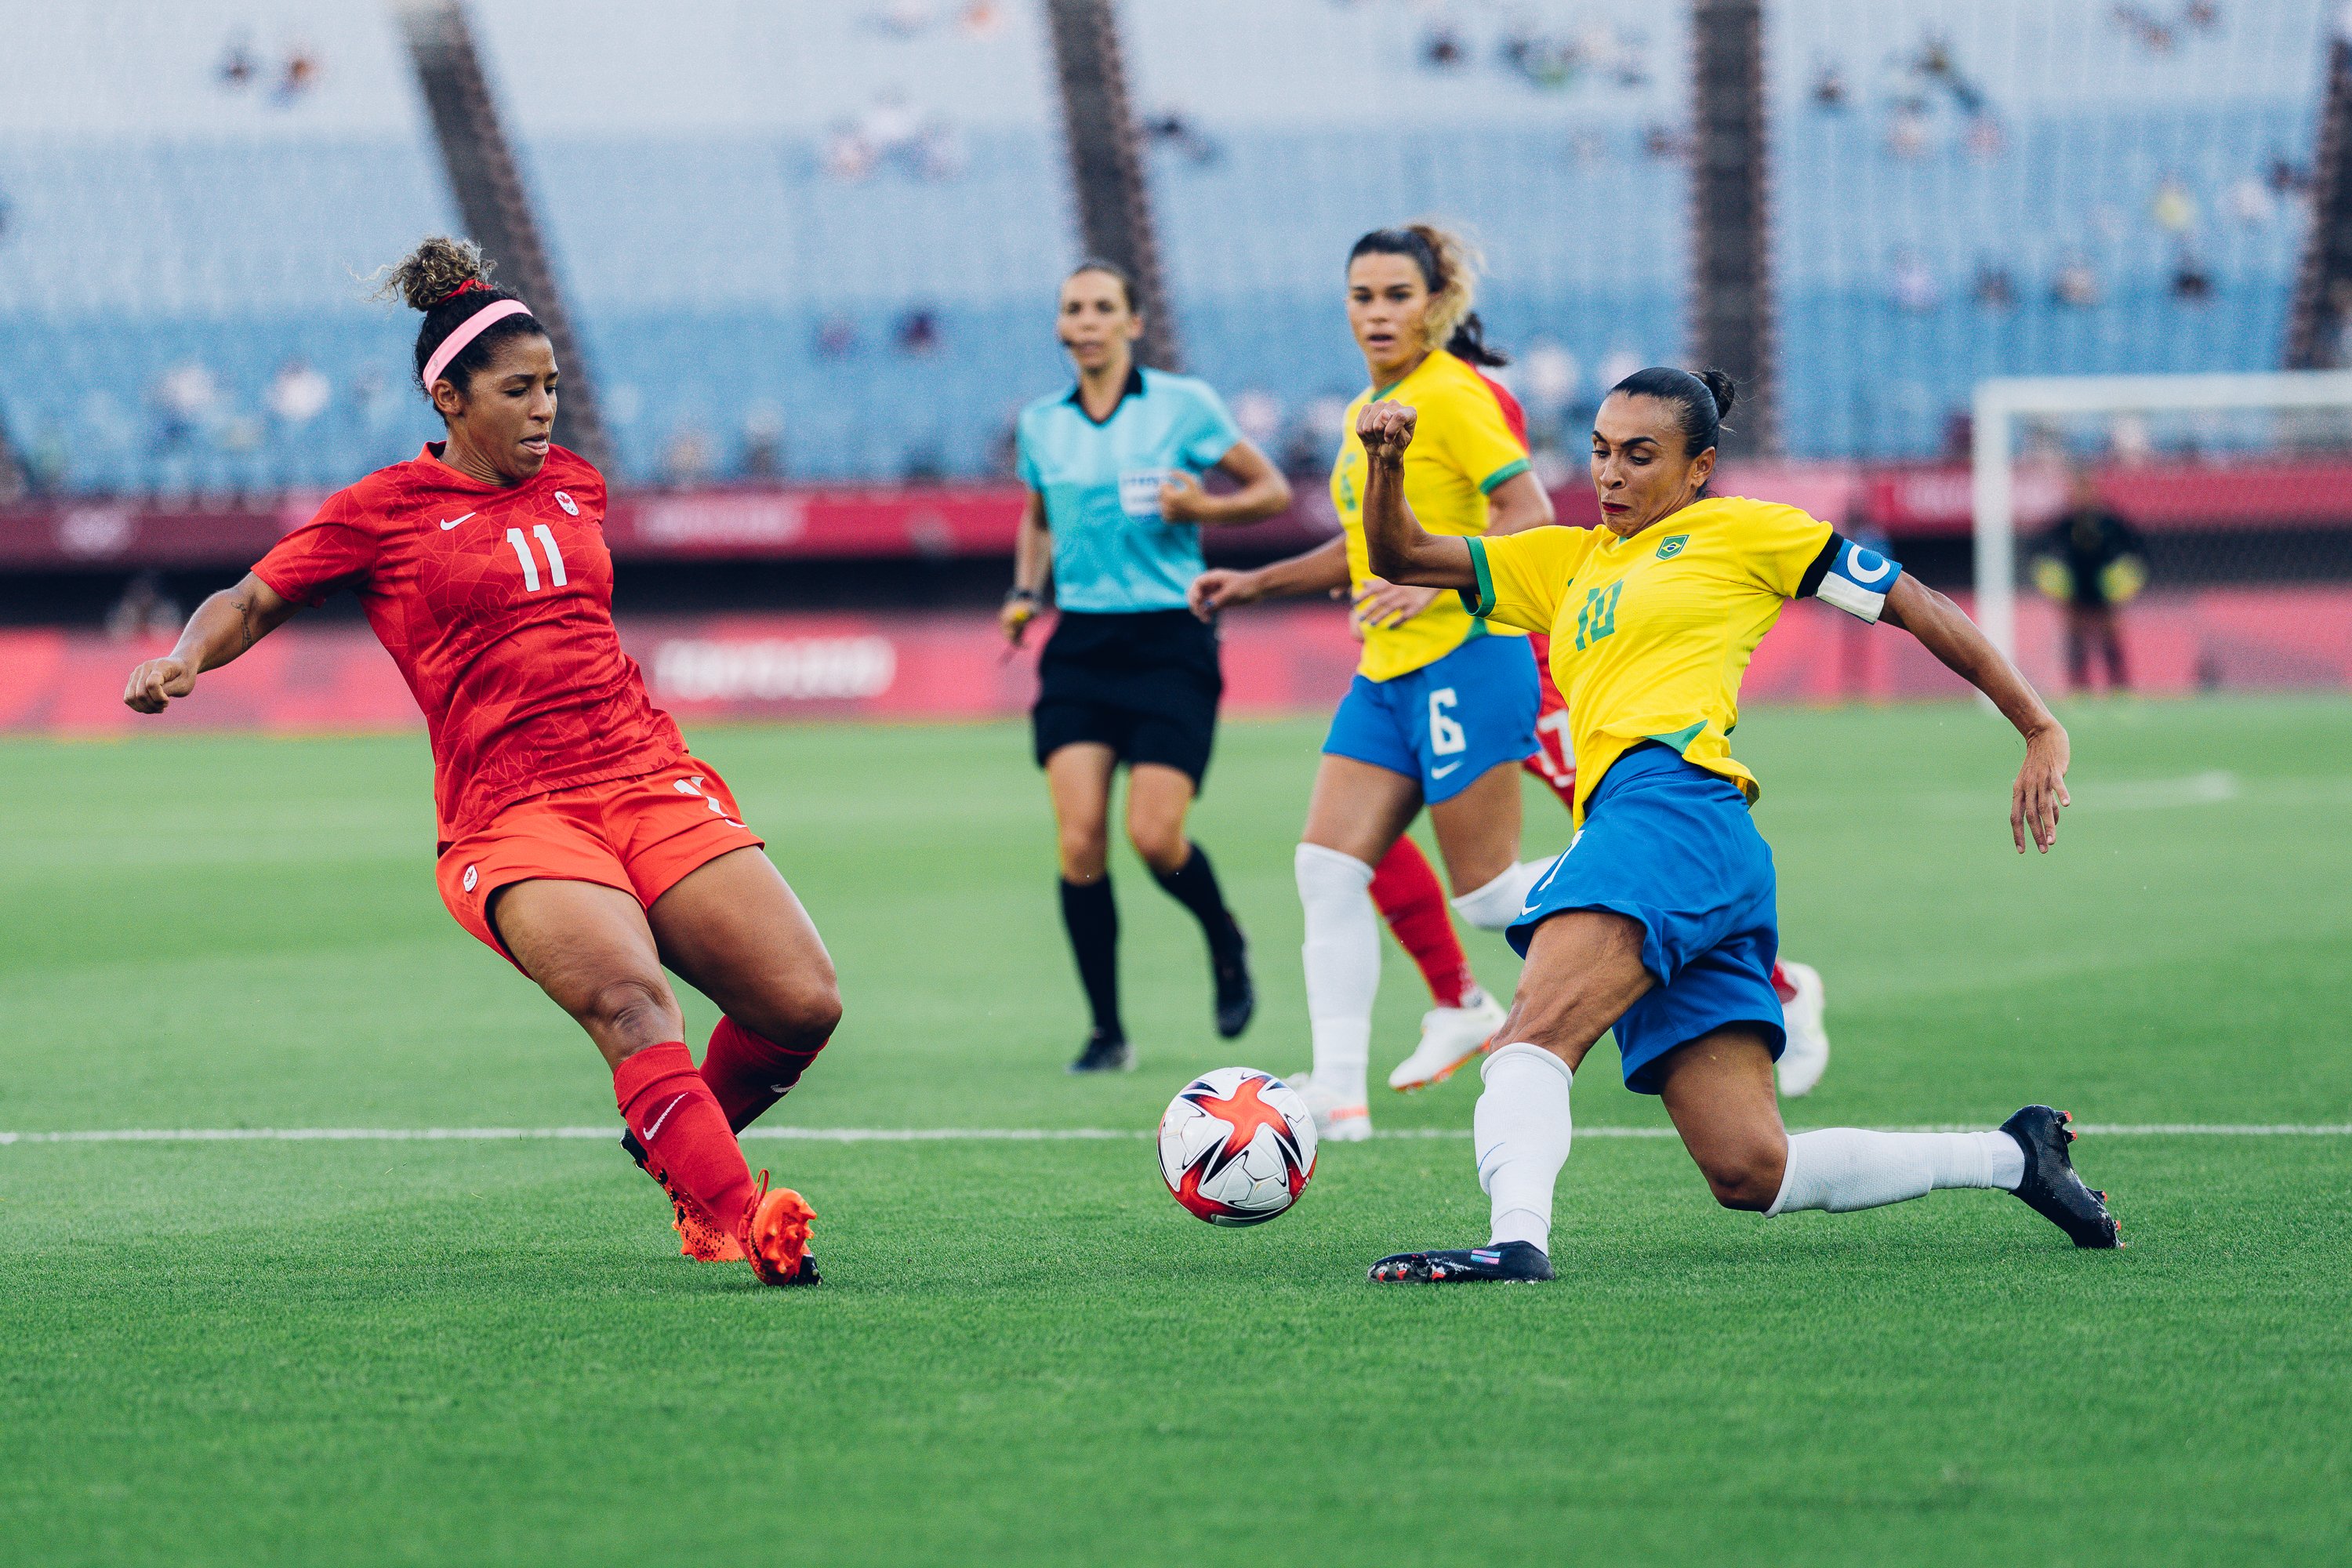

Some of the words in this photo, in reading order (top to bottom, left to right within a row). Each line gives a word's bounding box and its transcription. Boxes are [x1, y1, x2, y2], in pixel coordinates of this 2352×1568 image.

[506, 524, 568, 592] 11
[1847, 543, 1891, 584] C
[1575, 578, 1624, 652] 10
[1428, 687, 1467, 757] 6
